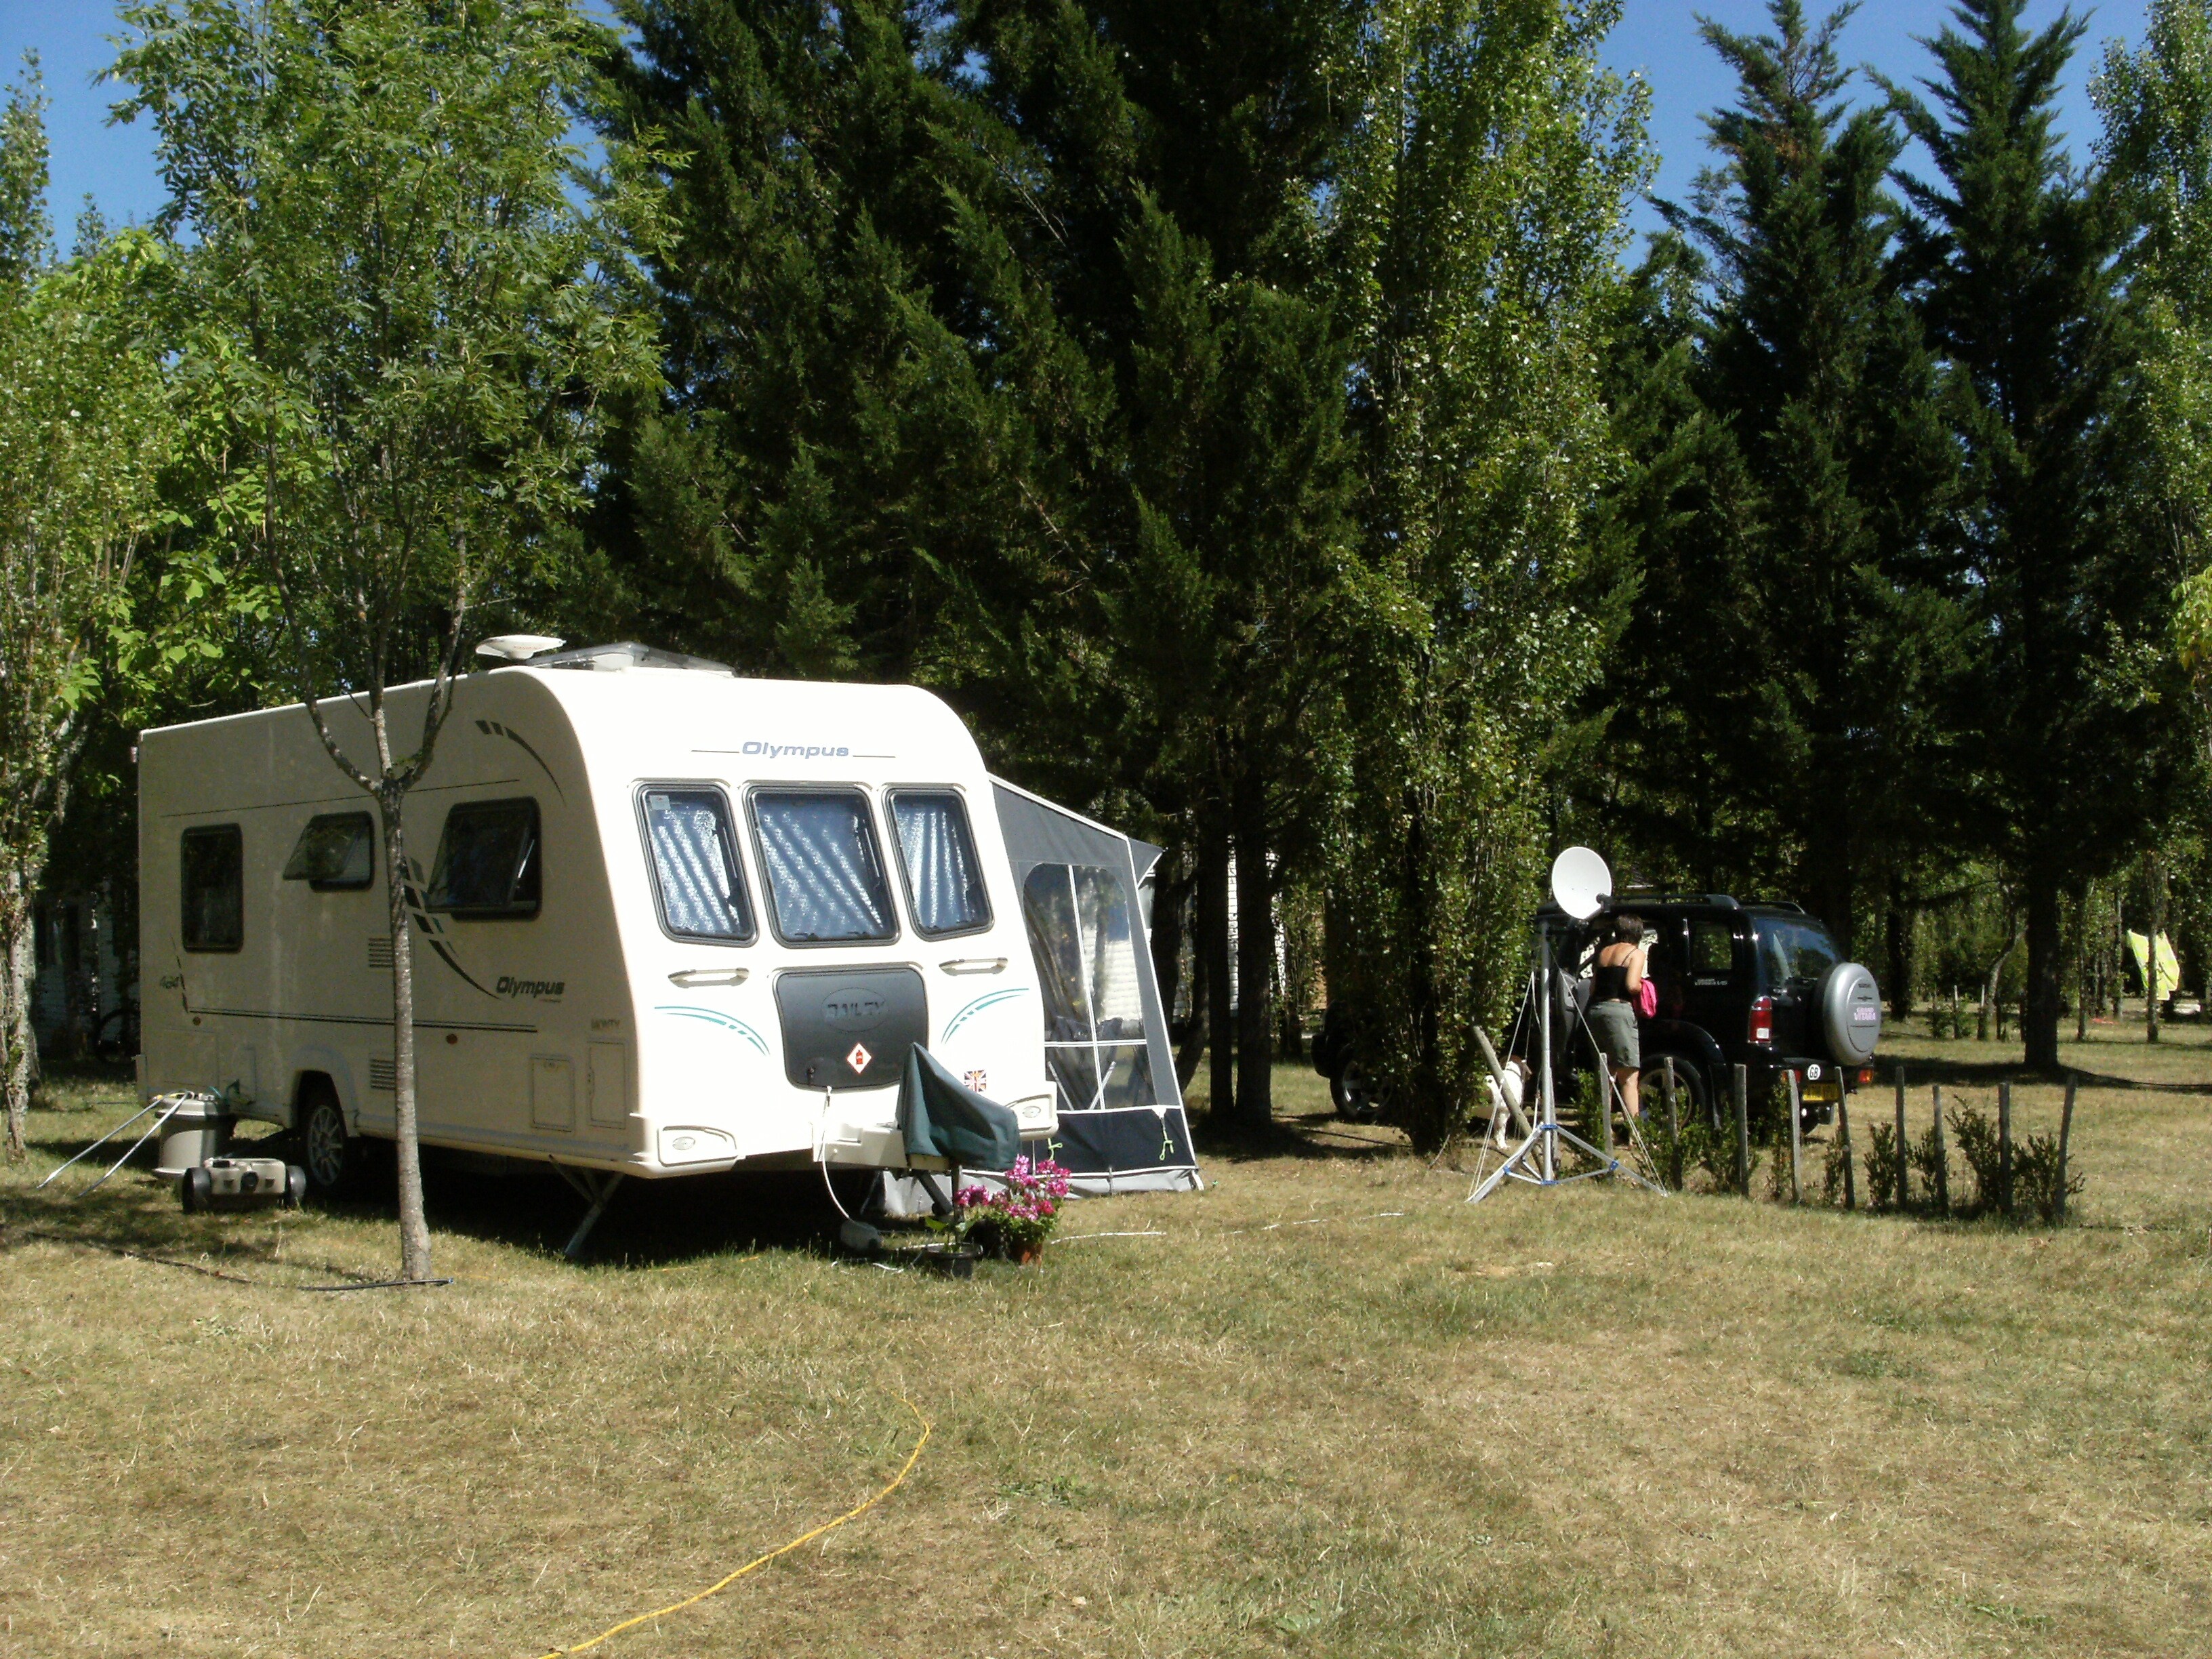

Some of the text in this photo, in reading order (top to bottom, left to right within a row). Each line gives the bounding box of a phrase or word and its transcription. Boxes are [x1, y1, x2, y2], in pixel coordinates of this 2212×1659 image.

[742, 741, 849, 759] Olympus
[496, 977, 565, 998] Olympus
[1809, 1067, 1819, 1078] GB
